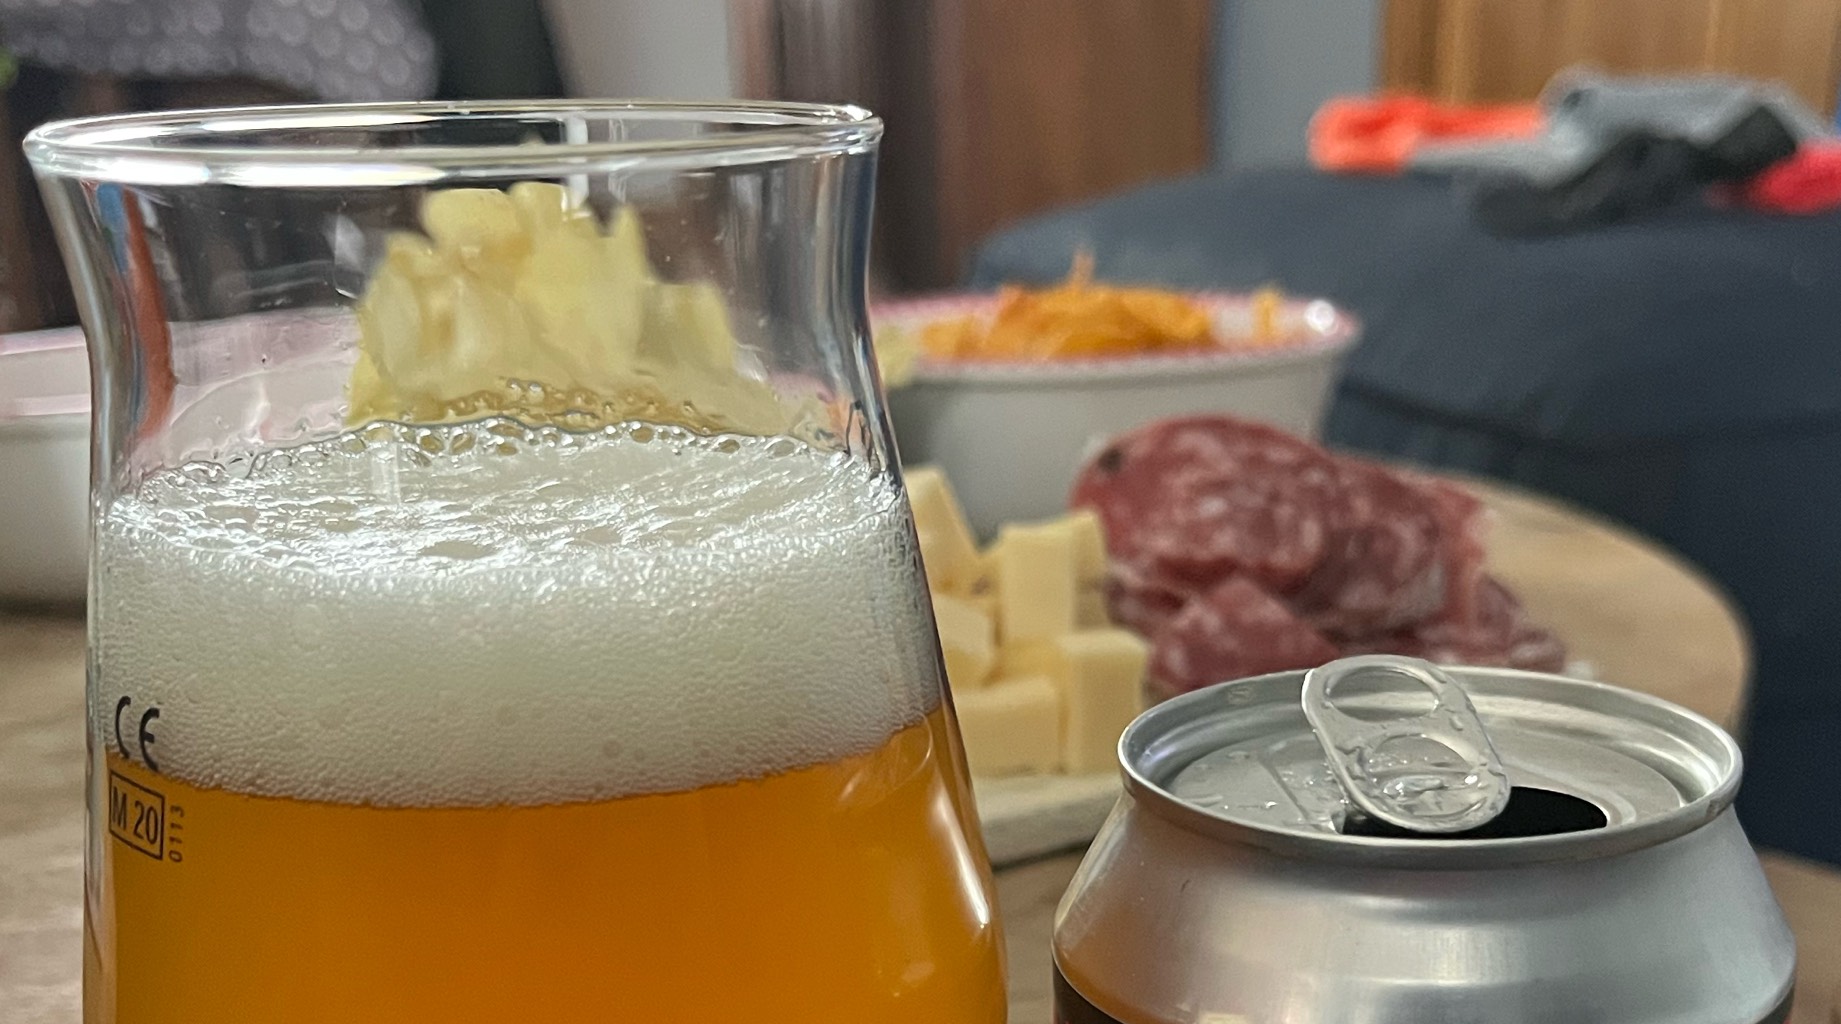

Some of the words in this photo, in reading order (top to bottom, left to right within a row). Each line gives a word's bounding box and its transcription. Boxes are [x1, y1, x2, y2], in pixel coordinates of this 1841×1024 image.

[115, 696, 160, 773] CE
[133, 800, 159, 845] 20
[168, 804, 185, 864] 0113
